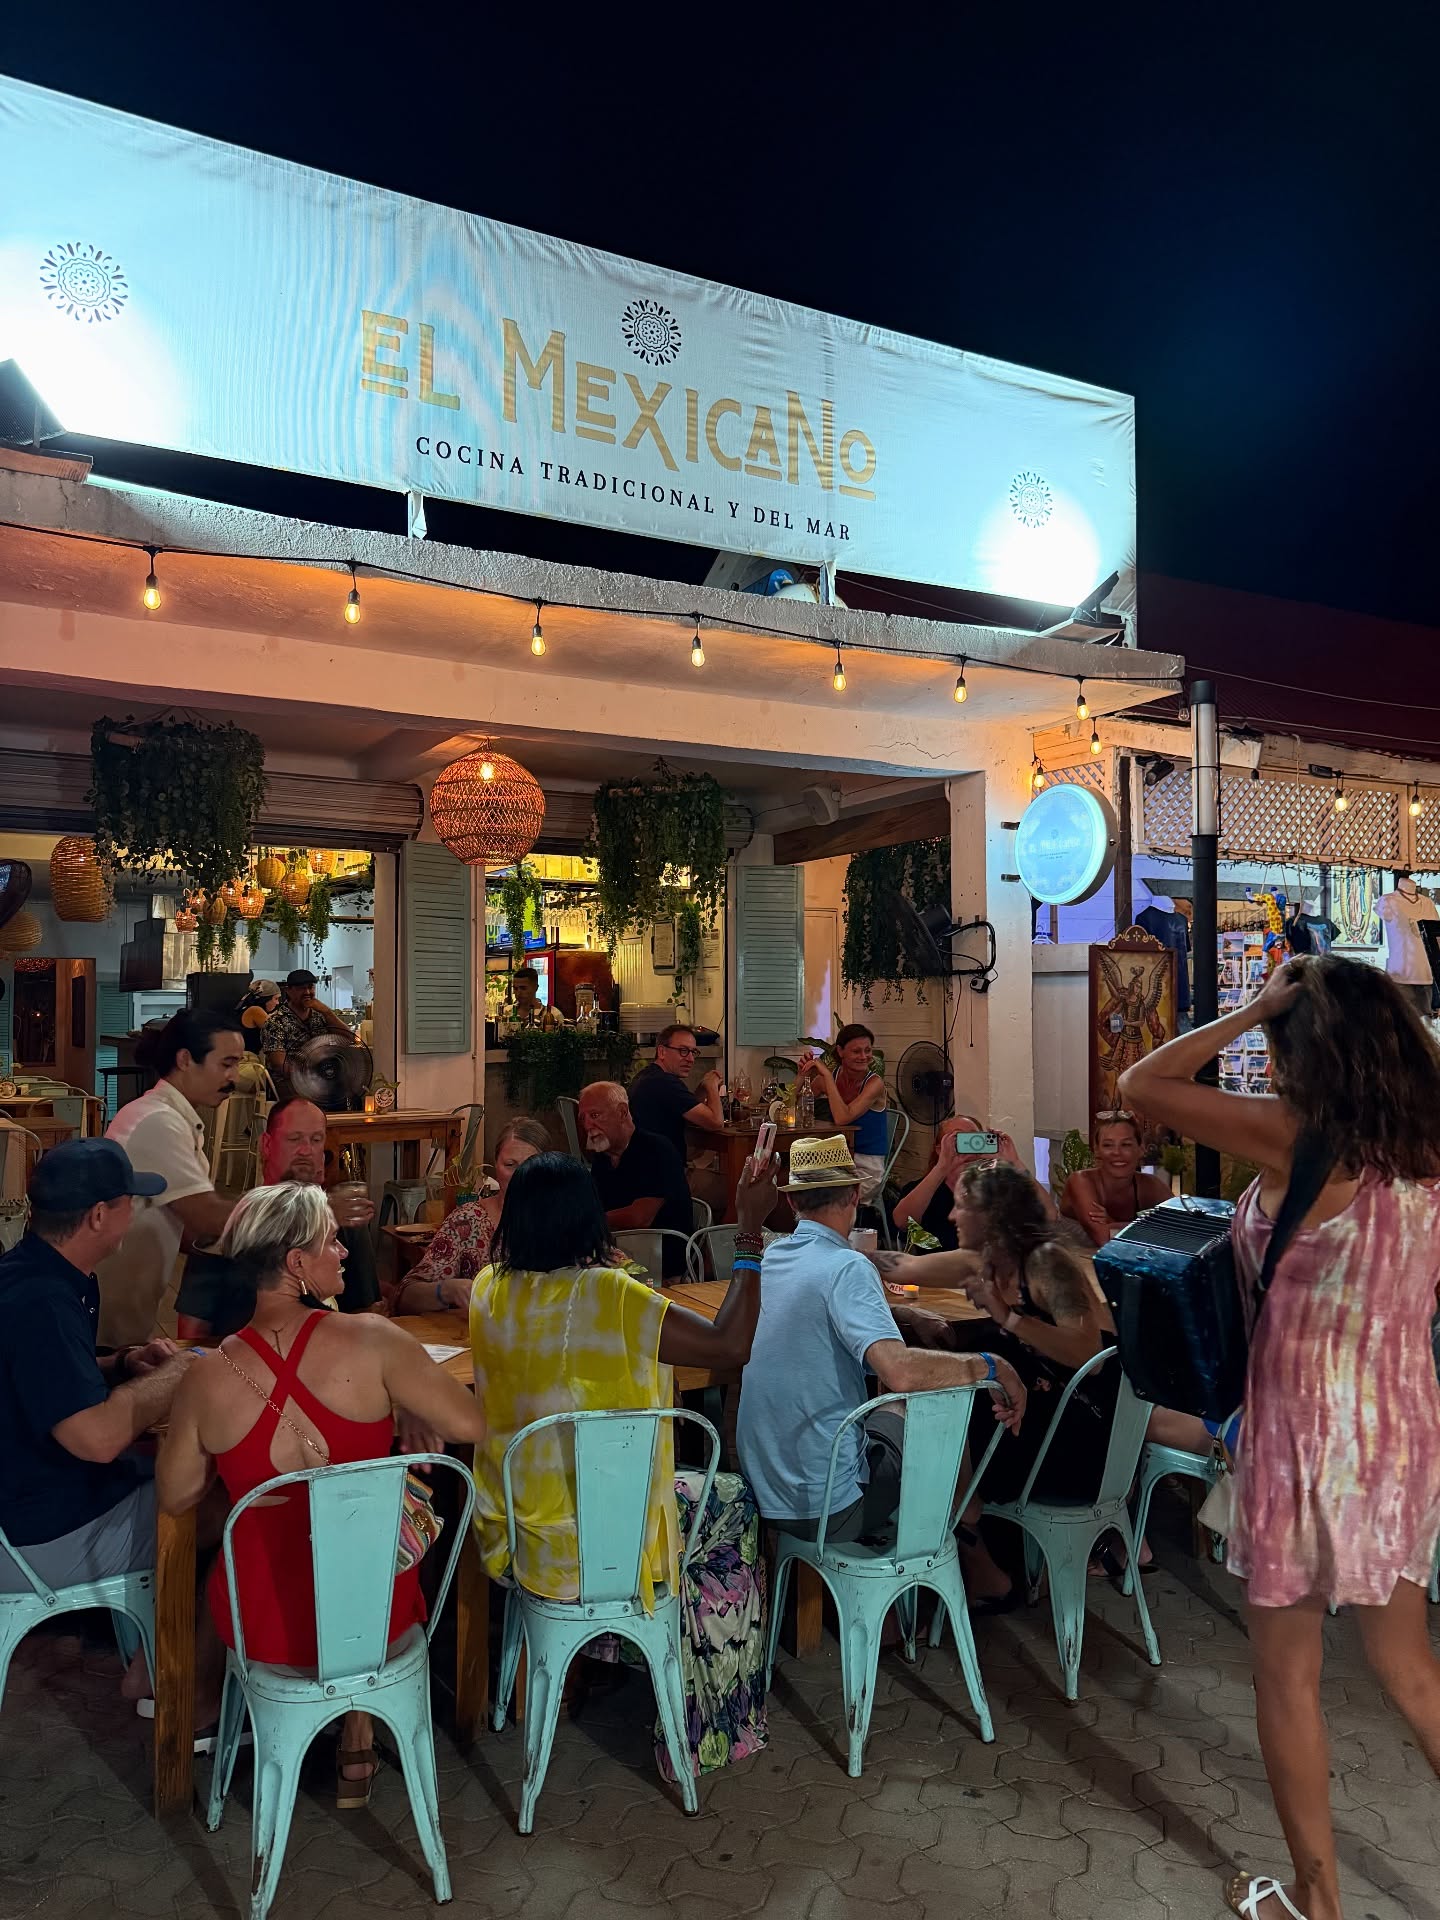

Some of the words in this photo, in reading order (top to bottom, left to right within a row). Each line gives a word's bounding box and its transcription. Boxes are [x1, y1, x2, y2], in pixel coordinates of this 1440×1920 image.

[361, 309, 460, 411] EL
[416, 436, 525, 475] COCINA
[540, 461, 715, 514] TRADICIONAL
[727, 501, 740, 519] Y
[753, 506, 794, 530] DEL
[806, 517, 851, 541] MAR
